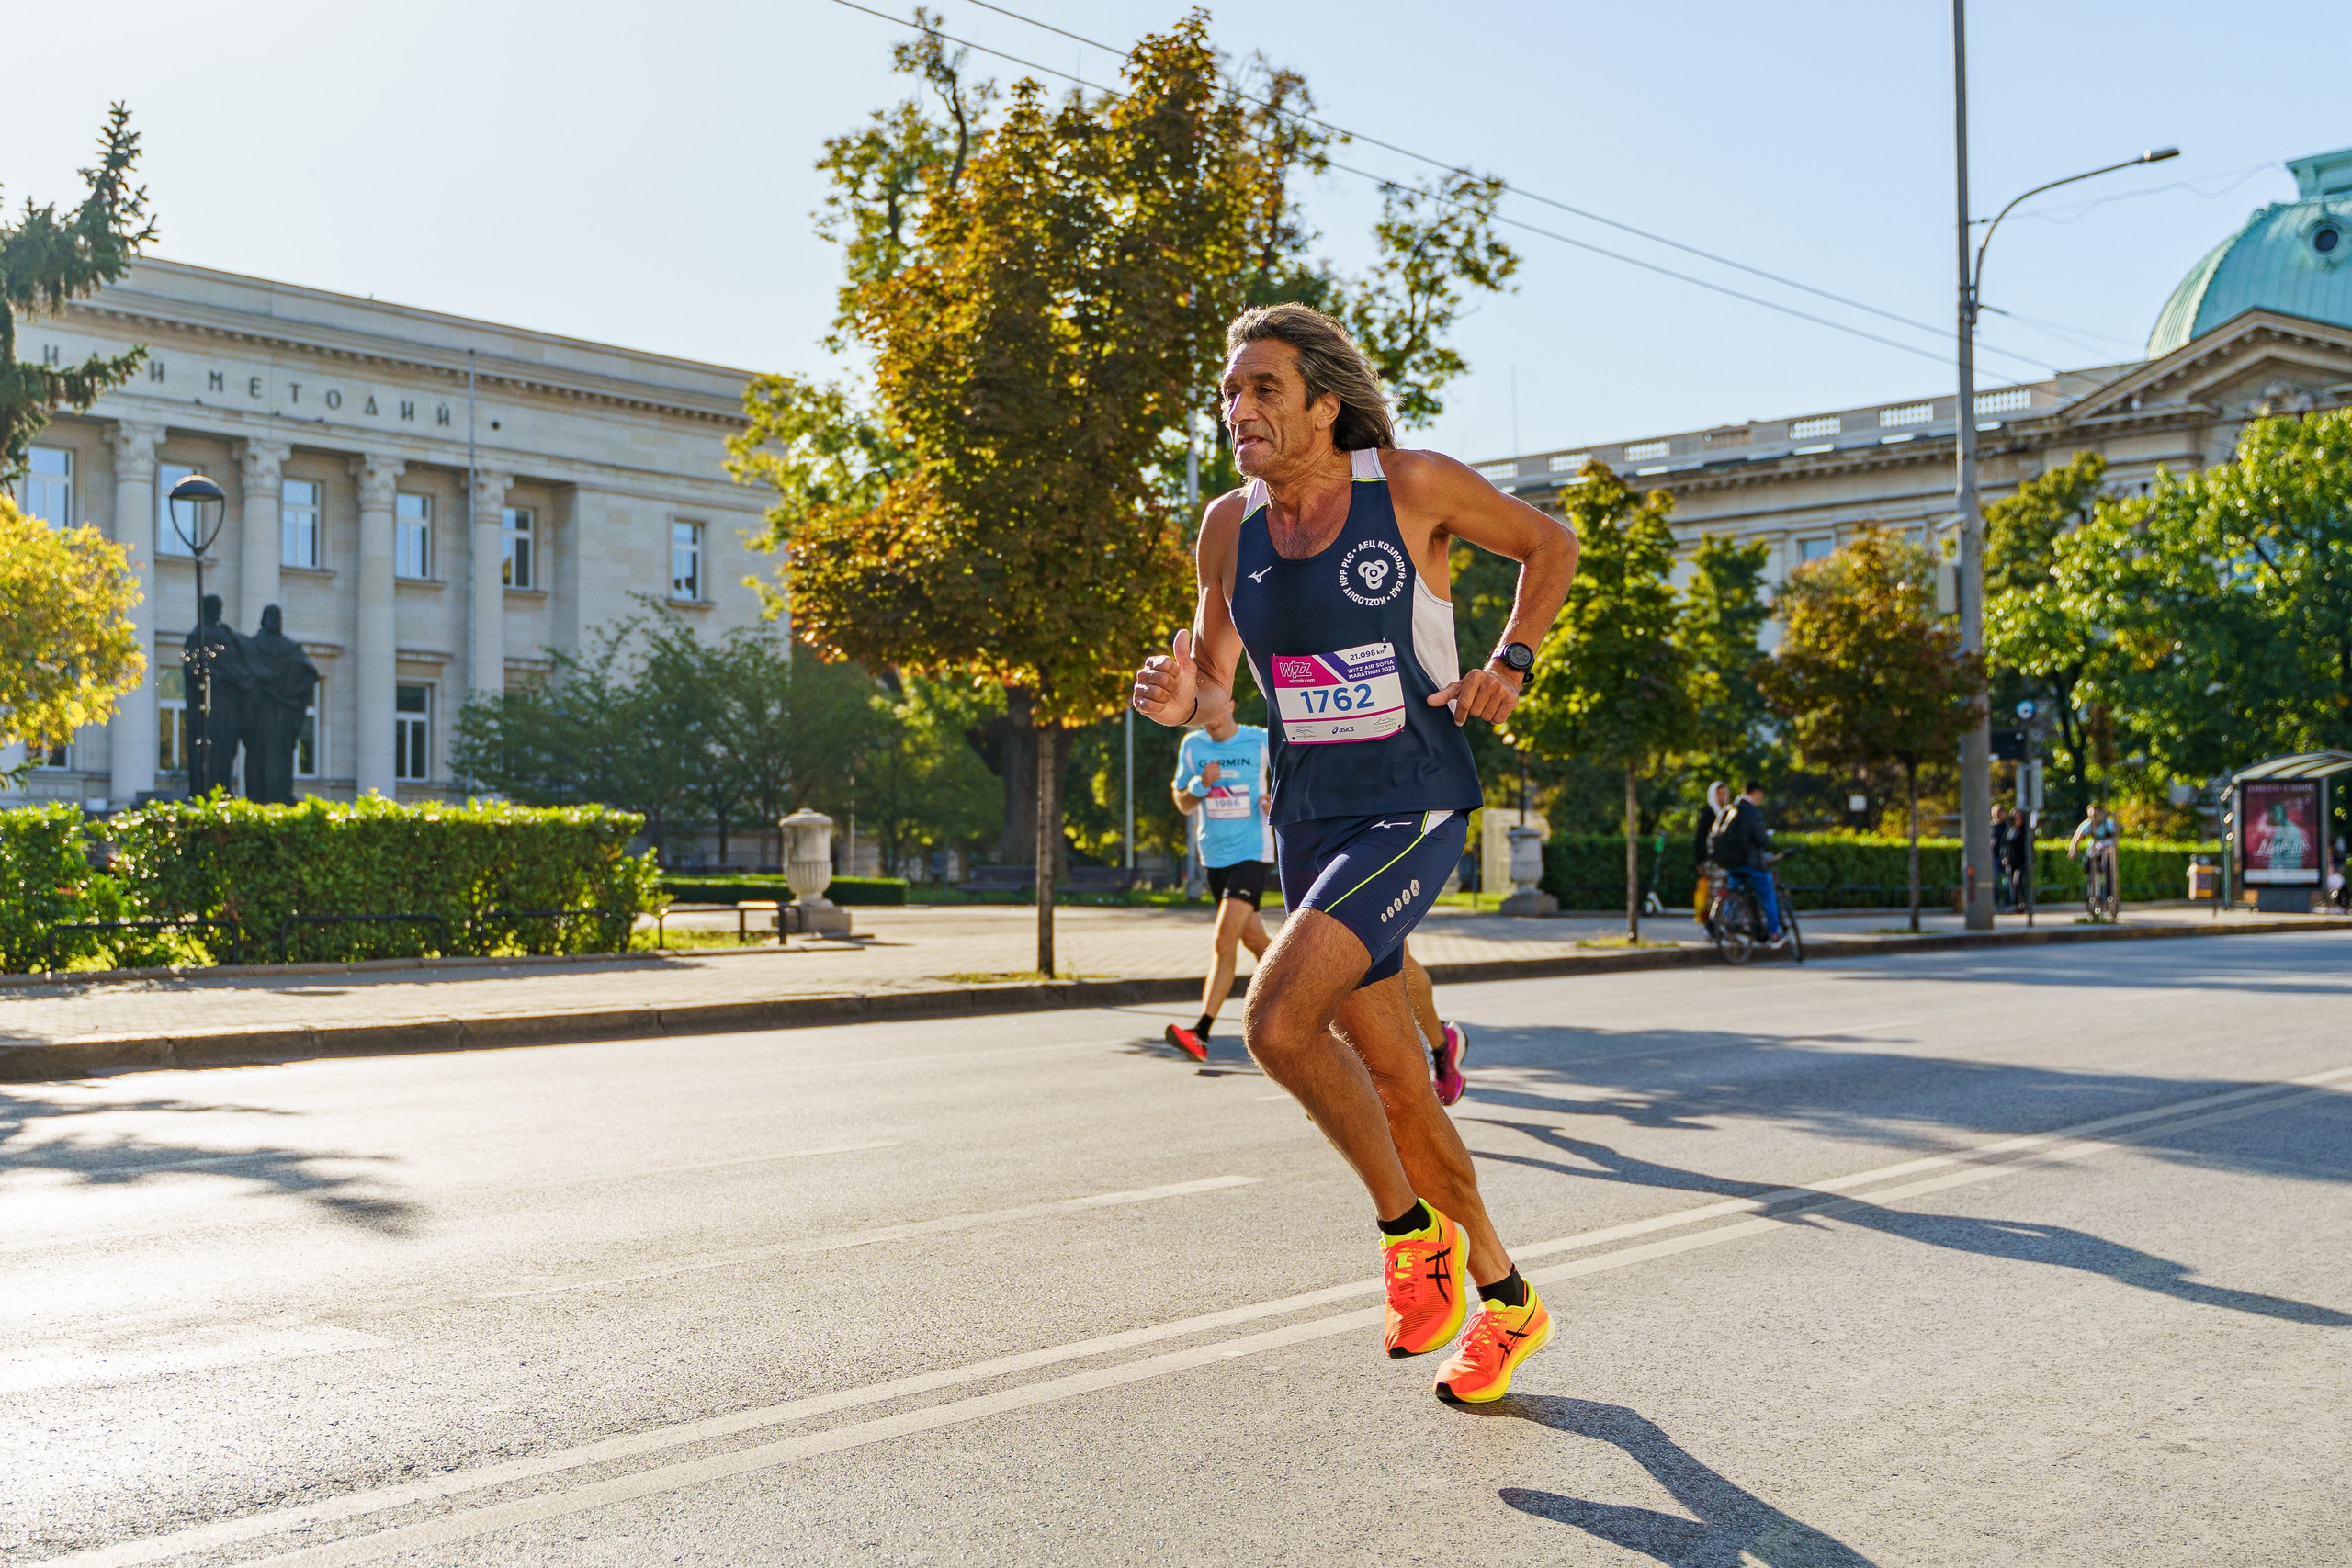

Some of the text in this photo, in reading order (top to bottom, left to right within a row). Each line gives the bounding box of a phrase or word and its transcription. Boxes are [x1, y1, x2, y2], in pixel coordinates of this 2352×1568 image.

[209, 370, 451, 426] МЕТОДИЙ
[1358, 540, 1406, 598] АЕЦ КОЗЛОДУЙ ЕАД
[1340, 552, 1386, 606] KOZLODUY NPP PLC
[1350, 649, 1376, 660] 21.098
[1375, 660, 1395, 668] SOFIA
[1348, 669, 1381, 680] MARATHON
[1299, 683, 1374, 713] 1762
[1198, 758, 1251, 769] GRMIN
[1215, 799, 1240, 808] 1986
